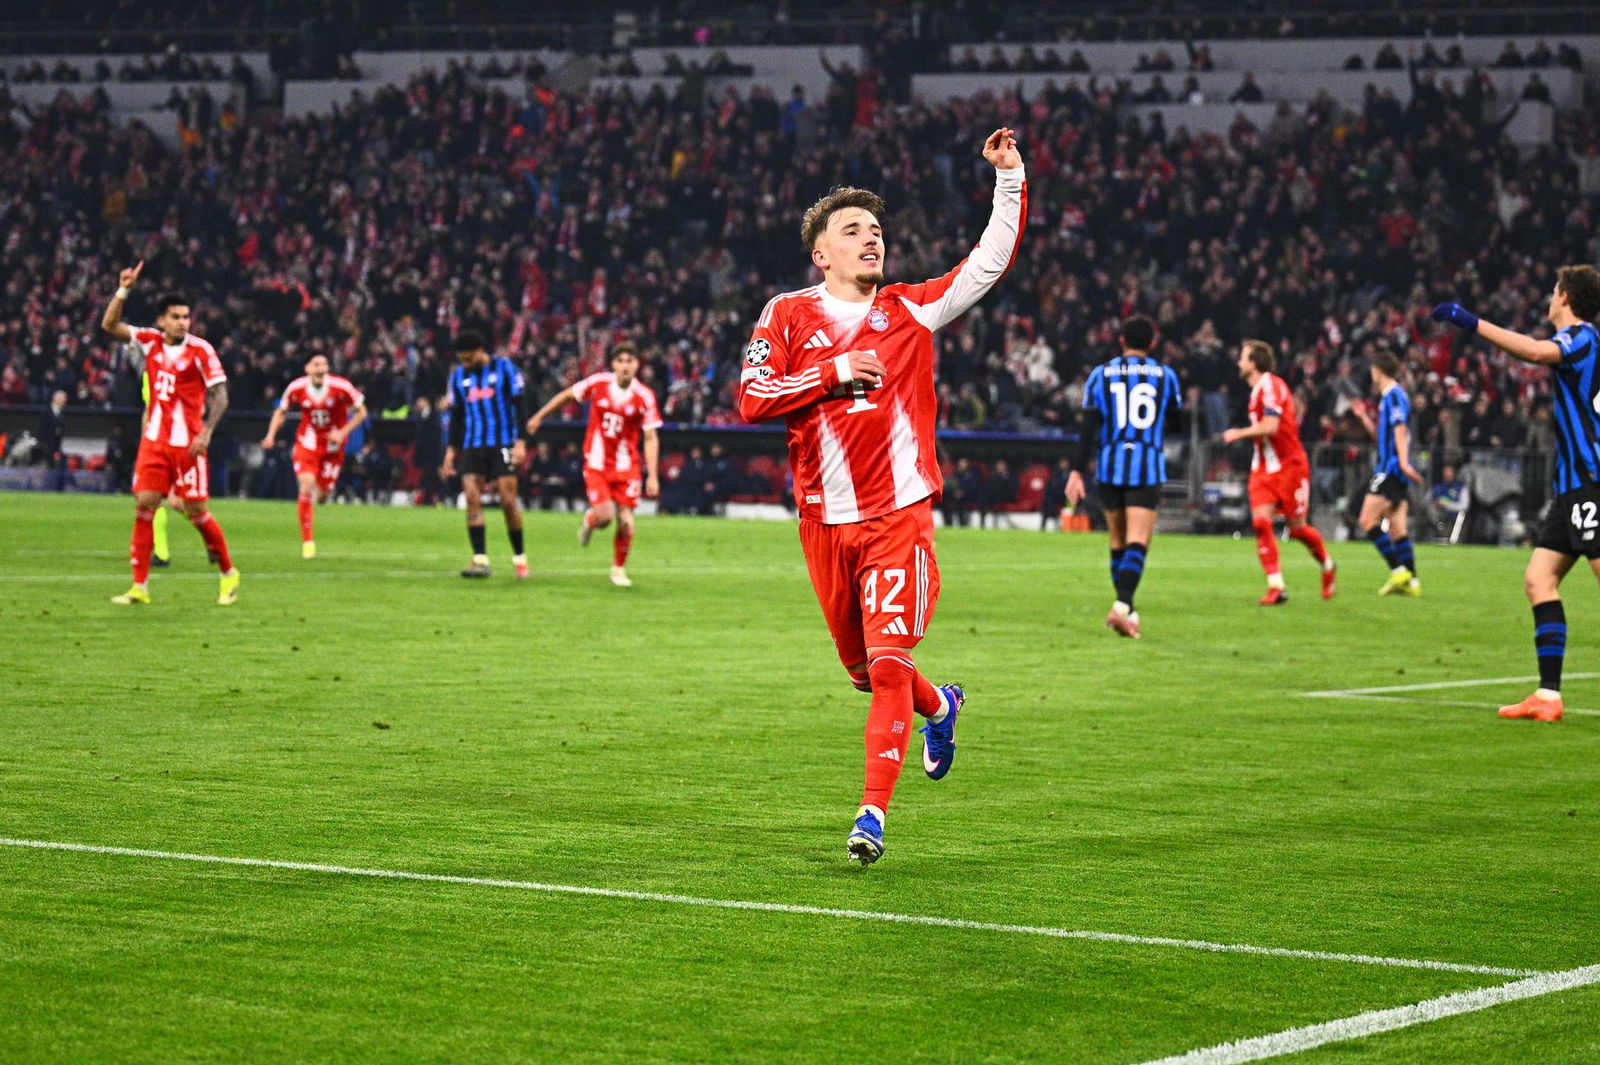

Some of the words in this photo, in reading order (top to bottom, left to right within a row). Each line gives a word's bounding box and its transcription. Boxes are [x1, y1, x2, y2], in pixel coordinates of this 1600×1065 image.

[154, 369, 176, 402] T
[1109, 381, 1157, 430] 16
[601, 411, 624, 438] T
[1571, 501, 1599, 530] 42
[864, 568, 906, 614] 42
